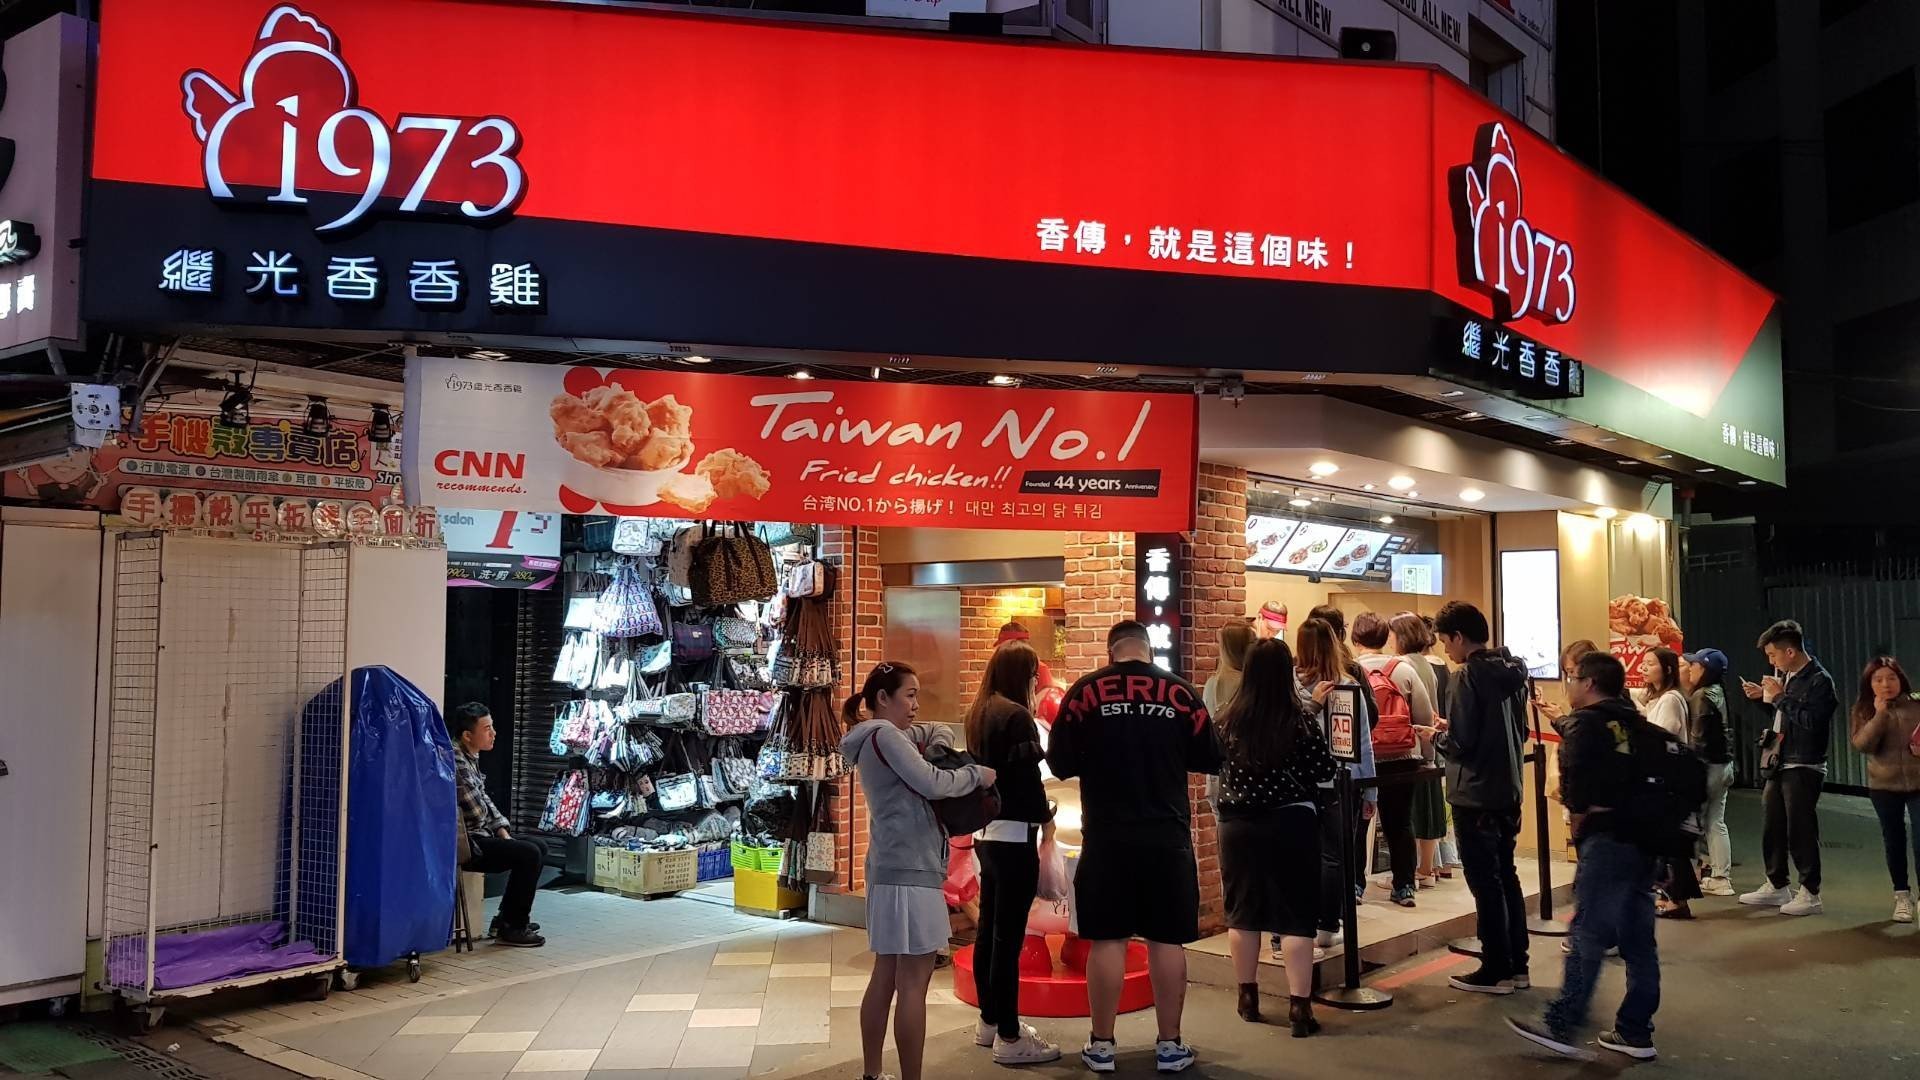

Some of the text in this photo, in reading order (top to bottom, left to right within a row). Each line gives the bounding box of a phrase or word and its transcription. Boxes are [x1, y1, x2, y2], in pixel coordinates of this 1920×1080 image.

[1305, 0, 1331, 36] NEW
[1422, 0, 1439, 29] ALL
[1441, 10, 1461, 44] NEW
[267, 95, 521, 233] 1973
[1035, 217, 1354, 270] 香傳，就是這個味！
[1495, 200, 1575, 322] 1973
[159, 249, 541, 307] 繼光香香雞
[750, 391, 1152, 462] Taiwan No.1
[434, 449, 526, 479] CNN
[800, 460, 1013, 489] Fried chicken!!
[436, 482, 528, 495] recommends.
[1054, 475, 1075, 489] 44
[1078, 478, 1121, 492] years
[444, 512, 475, 526] salon
[965, 500, 1103, 519] 대만 최고의 닭 튀김
[1068, 675, 1208, 736] MERICA
[1101, 702, 1176, 720] EST. 1776
[1333, 718, 1351, 734] 入口
